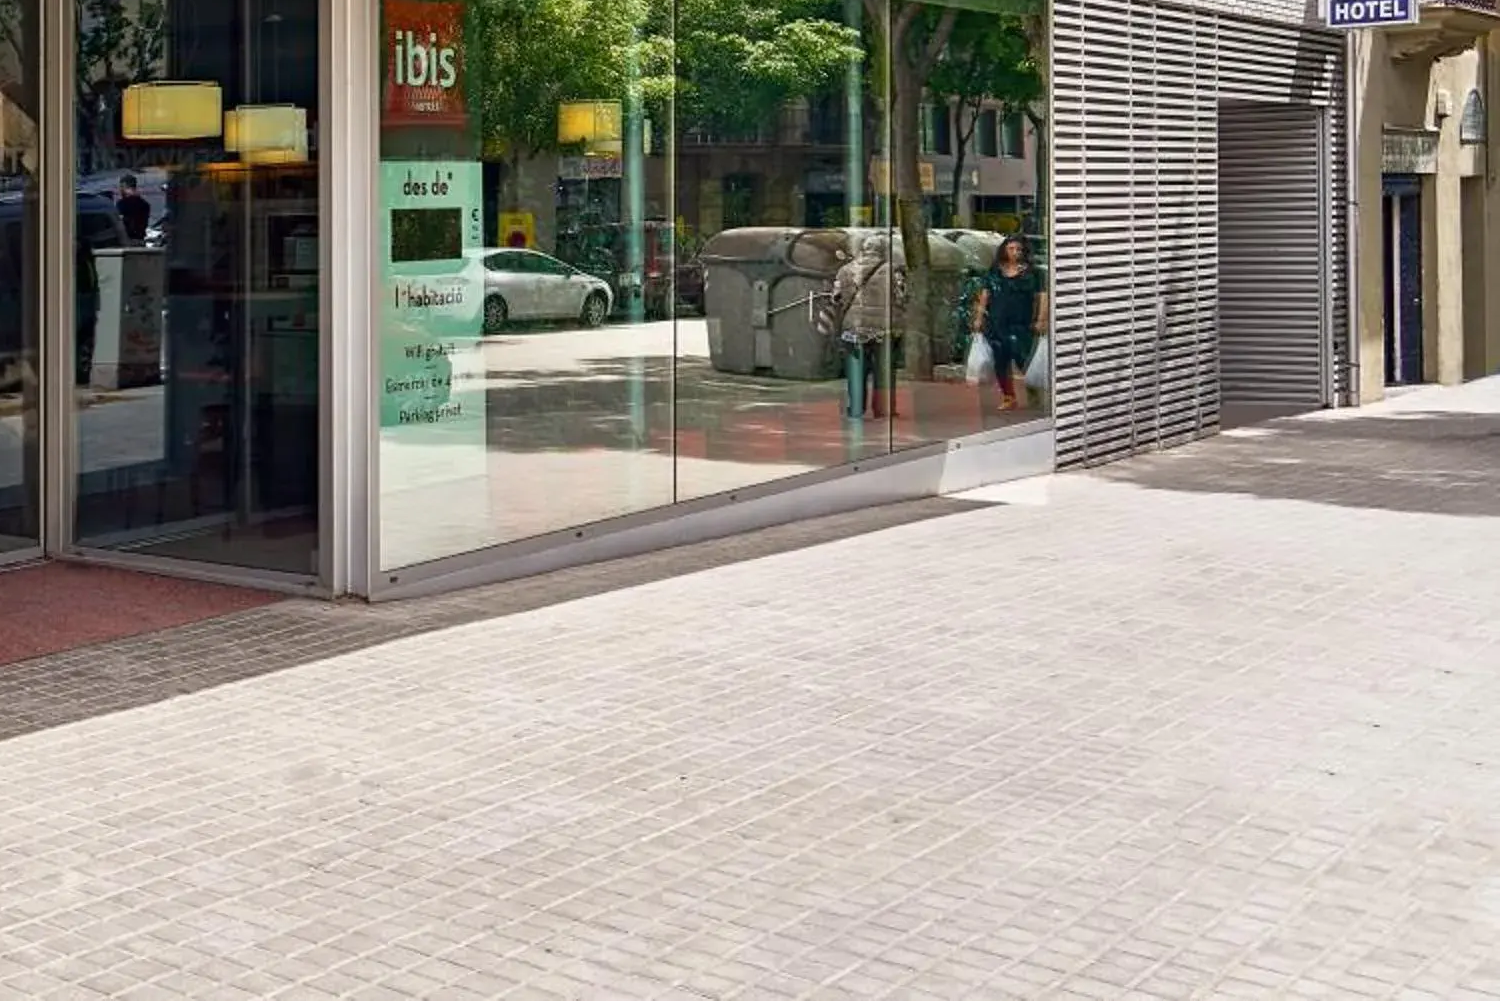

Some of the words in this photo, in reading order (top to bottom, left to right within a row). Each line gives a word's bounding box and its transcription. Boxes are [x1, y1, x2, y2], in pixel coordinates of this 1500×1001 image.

[1334, 0, 1406, 21] HOTEL
[395, 30, 457, 88] ibis
[403, 169, 428, 196] des
